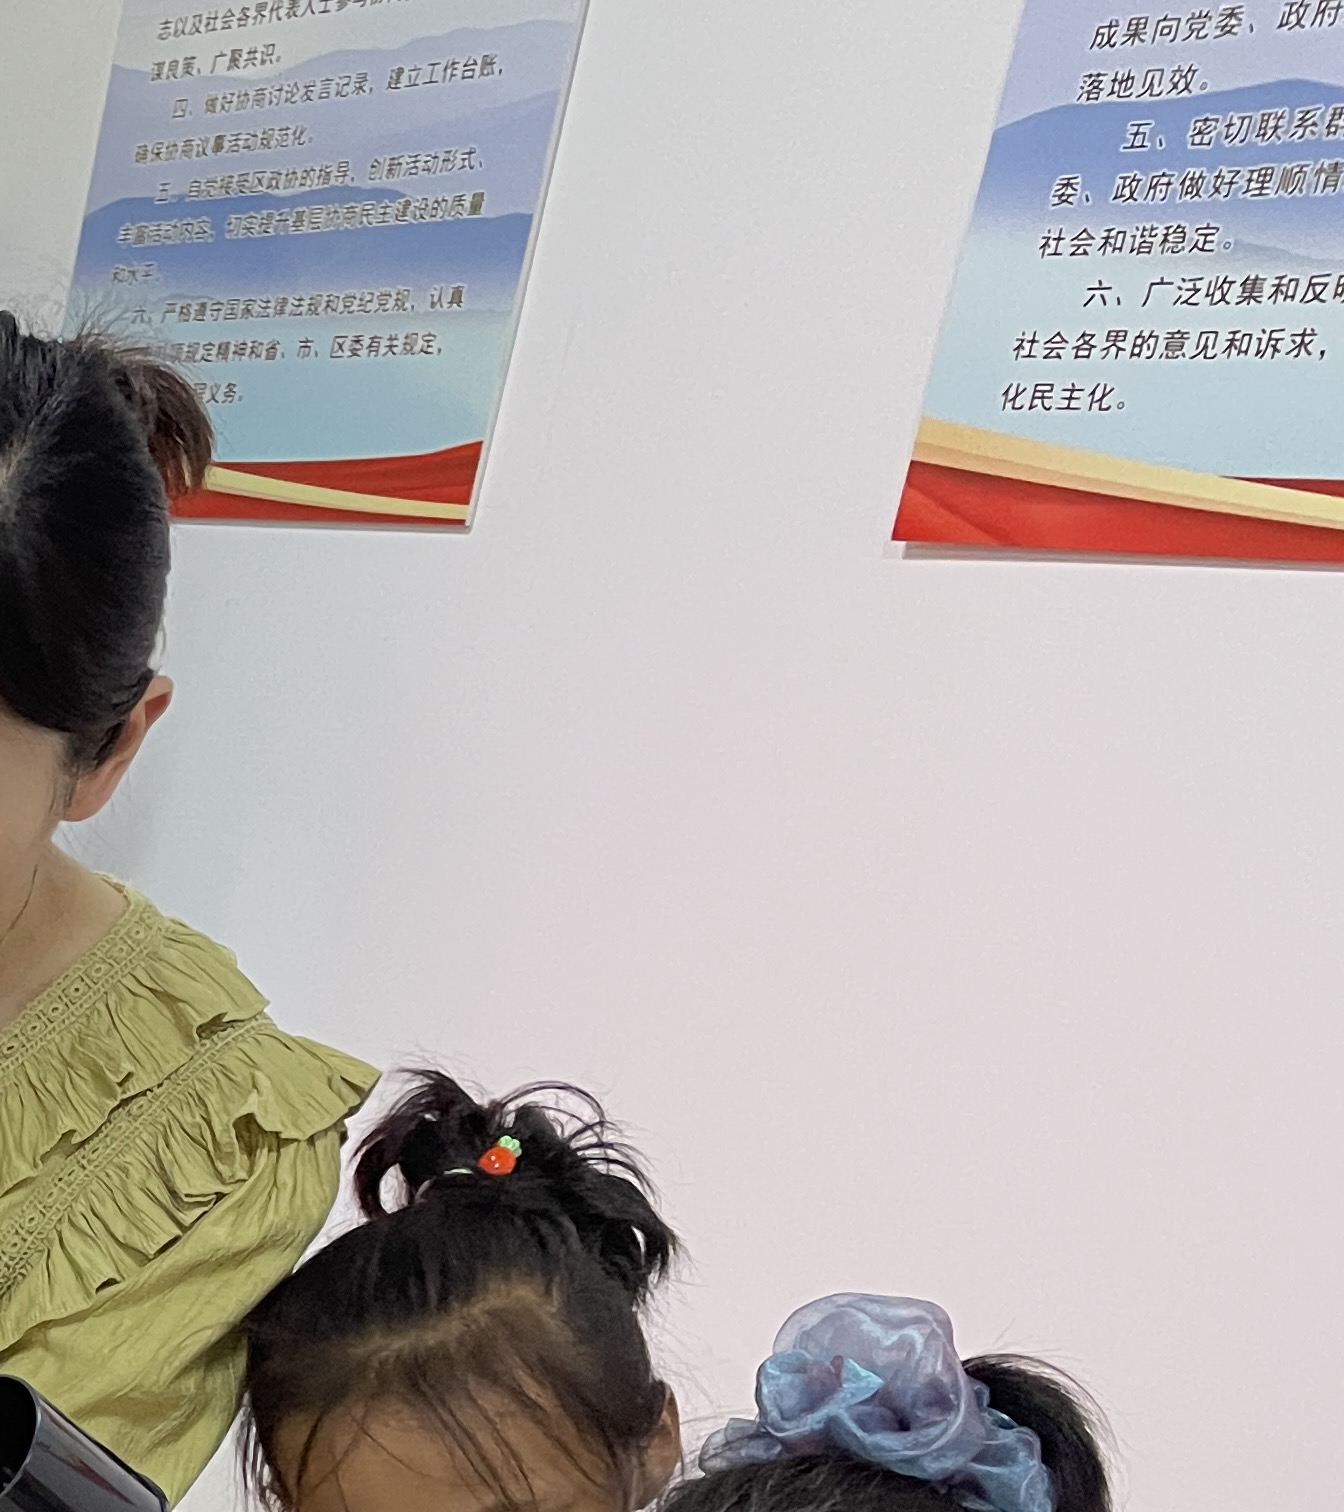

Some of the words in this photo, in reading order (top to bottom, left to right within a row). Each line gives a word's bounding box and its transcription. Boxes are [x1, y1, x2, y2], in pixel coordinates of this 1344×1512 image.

[1076, 64, 1209, 102] 落地见效。
[1050, 162, 1343, 207] 委、政府做好理顺情
[1039, 224, 1233, 258] 社会和谐稳定。
[1013, 328, 1327, 361] 社会各界的意见和诉求，
[1001, 383, 1128, 412] 化民主化。
